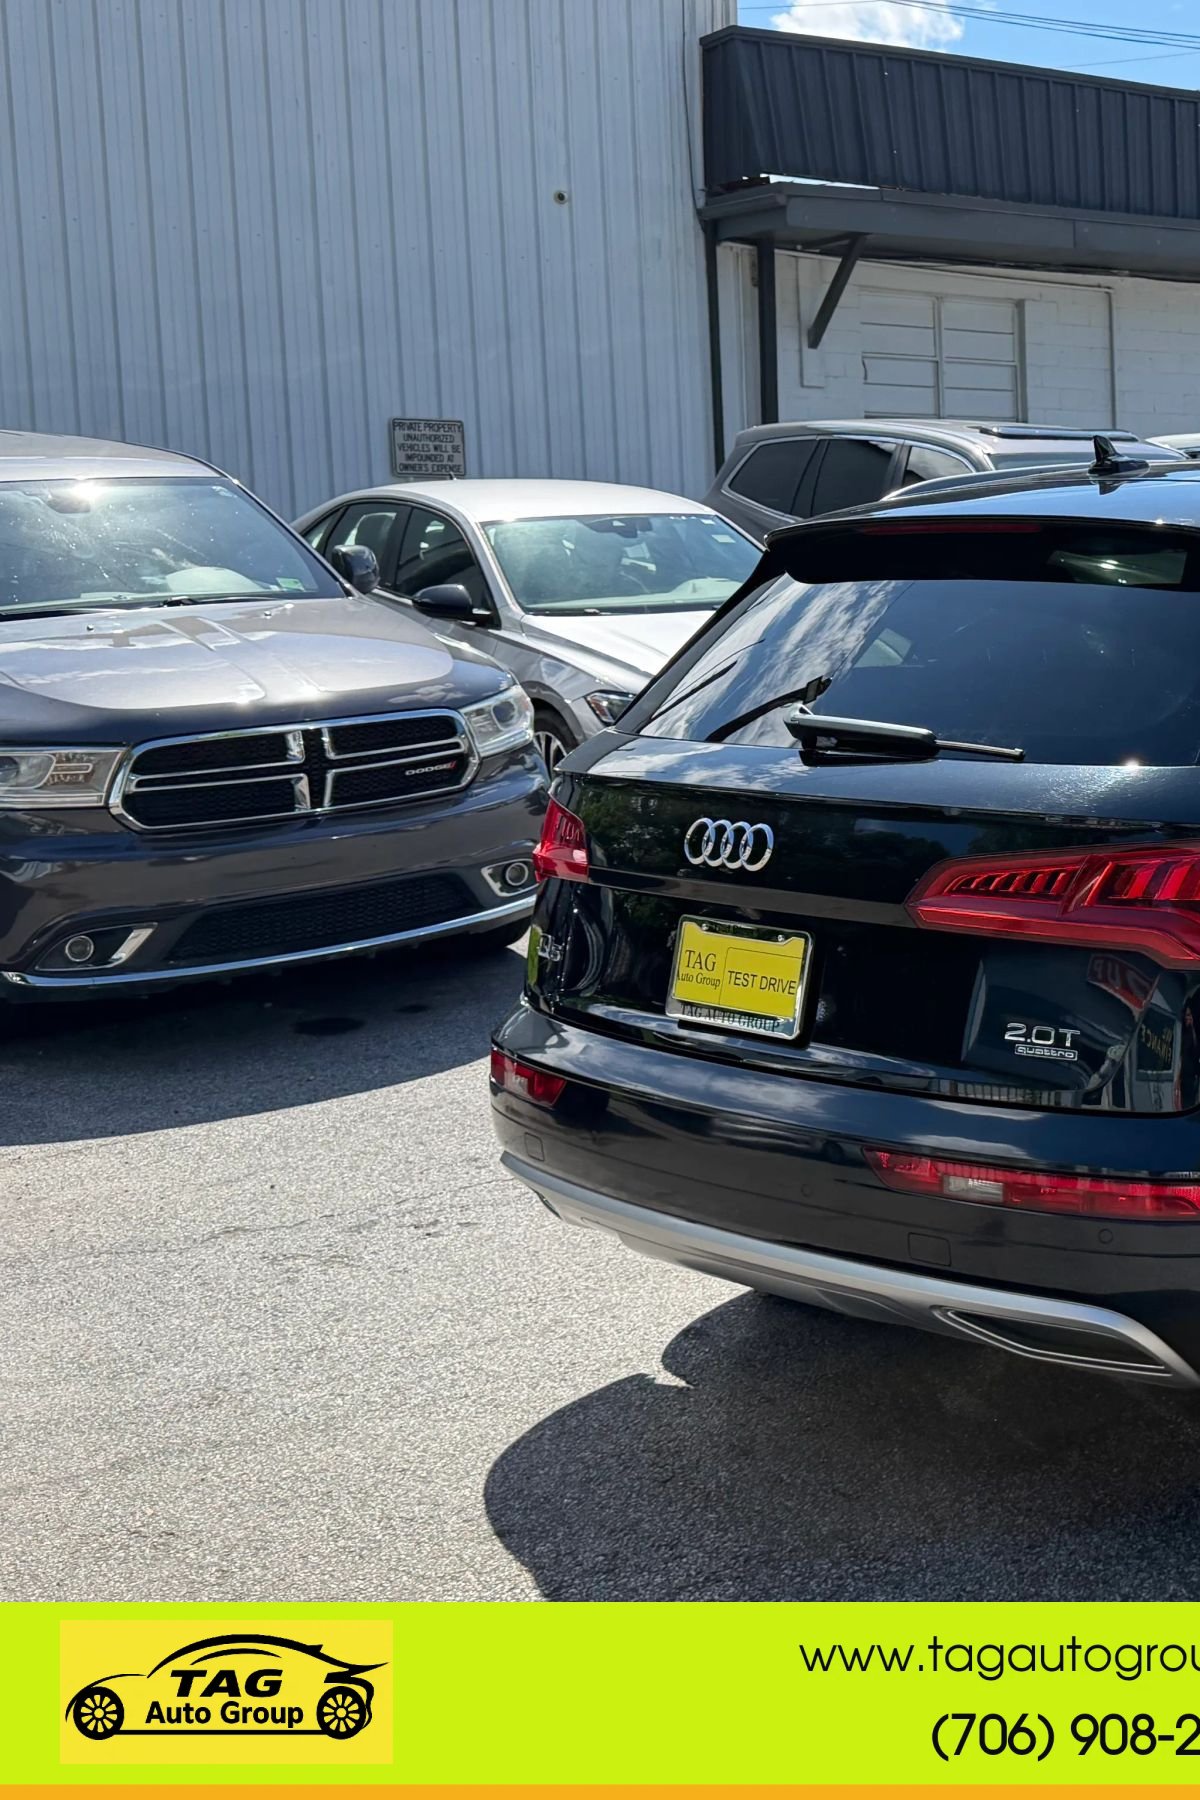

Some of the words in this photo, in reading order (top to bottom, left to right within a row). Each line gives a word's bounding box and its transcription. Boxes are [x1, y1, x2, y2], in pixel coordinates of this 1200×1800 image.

[393, 422, 422, 432] PRIVATE
[424, 423, 462, 433] PROPERTY
[403, 433, 454, 443] UNAUTHORIZED
[397, 443, 430, 452] VEHICLES
[433, 444, 450, 453] WILL
[451, 445, 461, 453] BE
[405, 453, 444, 463] IMPOUNDED
[447, 454, 455, 463] AT
[431, 464, 462, 473] EXPENSE
[405, 763, 452, 776] DODGE
[685, 949, 717, 972] TAG
[695, 972, 721, 990] Group
[727, 970, 757, 987] TEST
[760, 975, 797, 995] DRIVE
[681, 1003, 702, 1018] TAG
[1004, 1022, 1081, 1047] 2.0T
[1017, 1046, 1075, 1059] quattro
